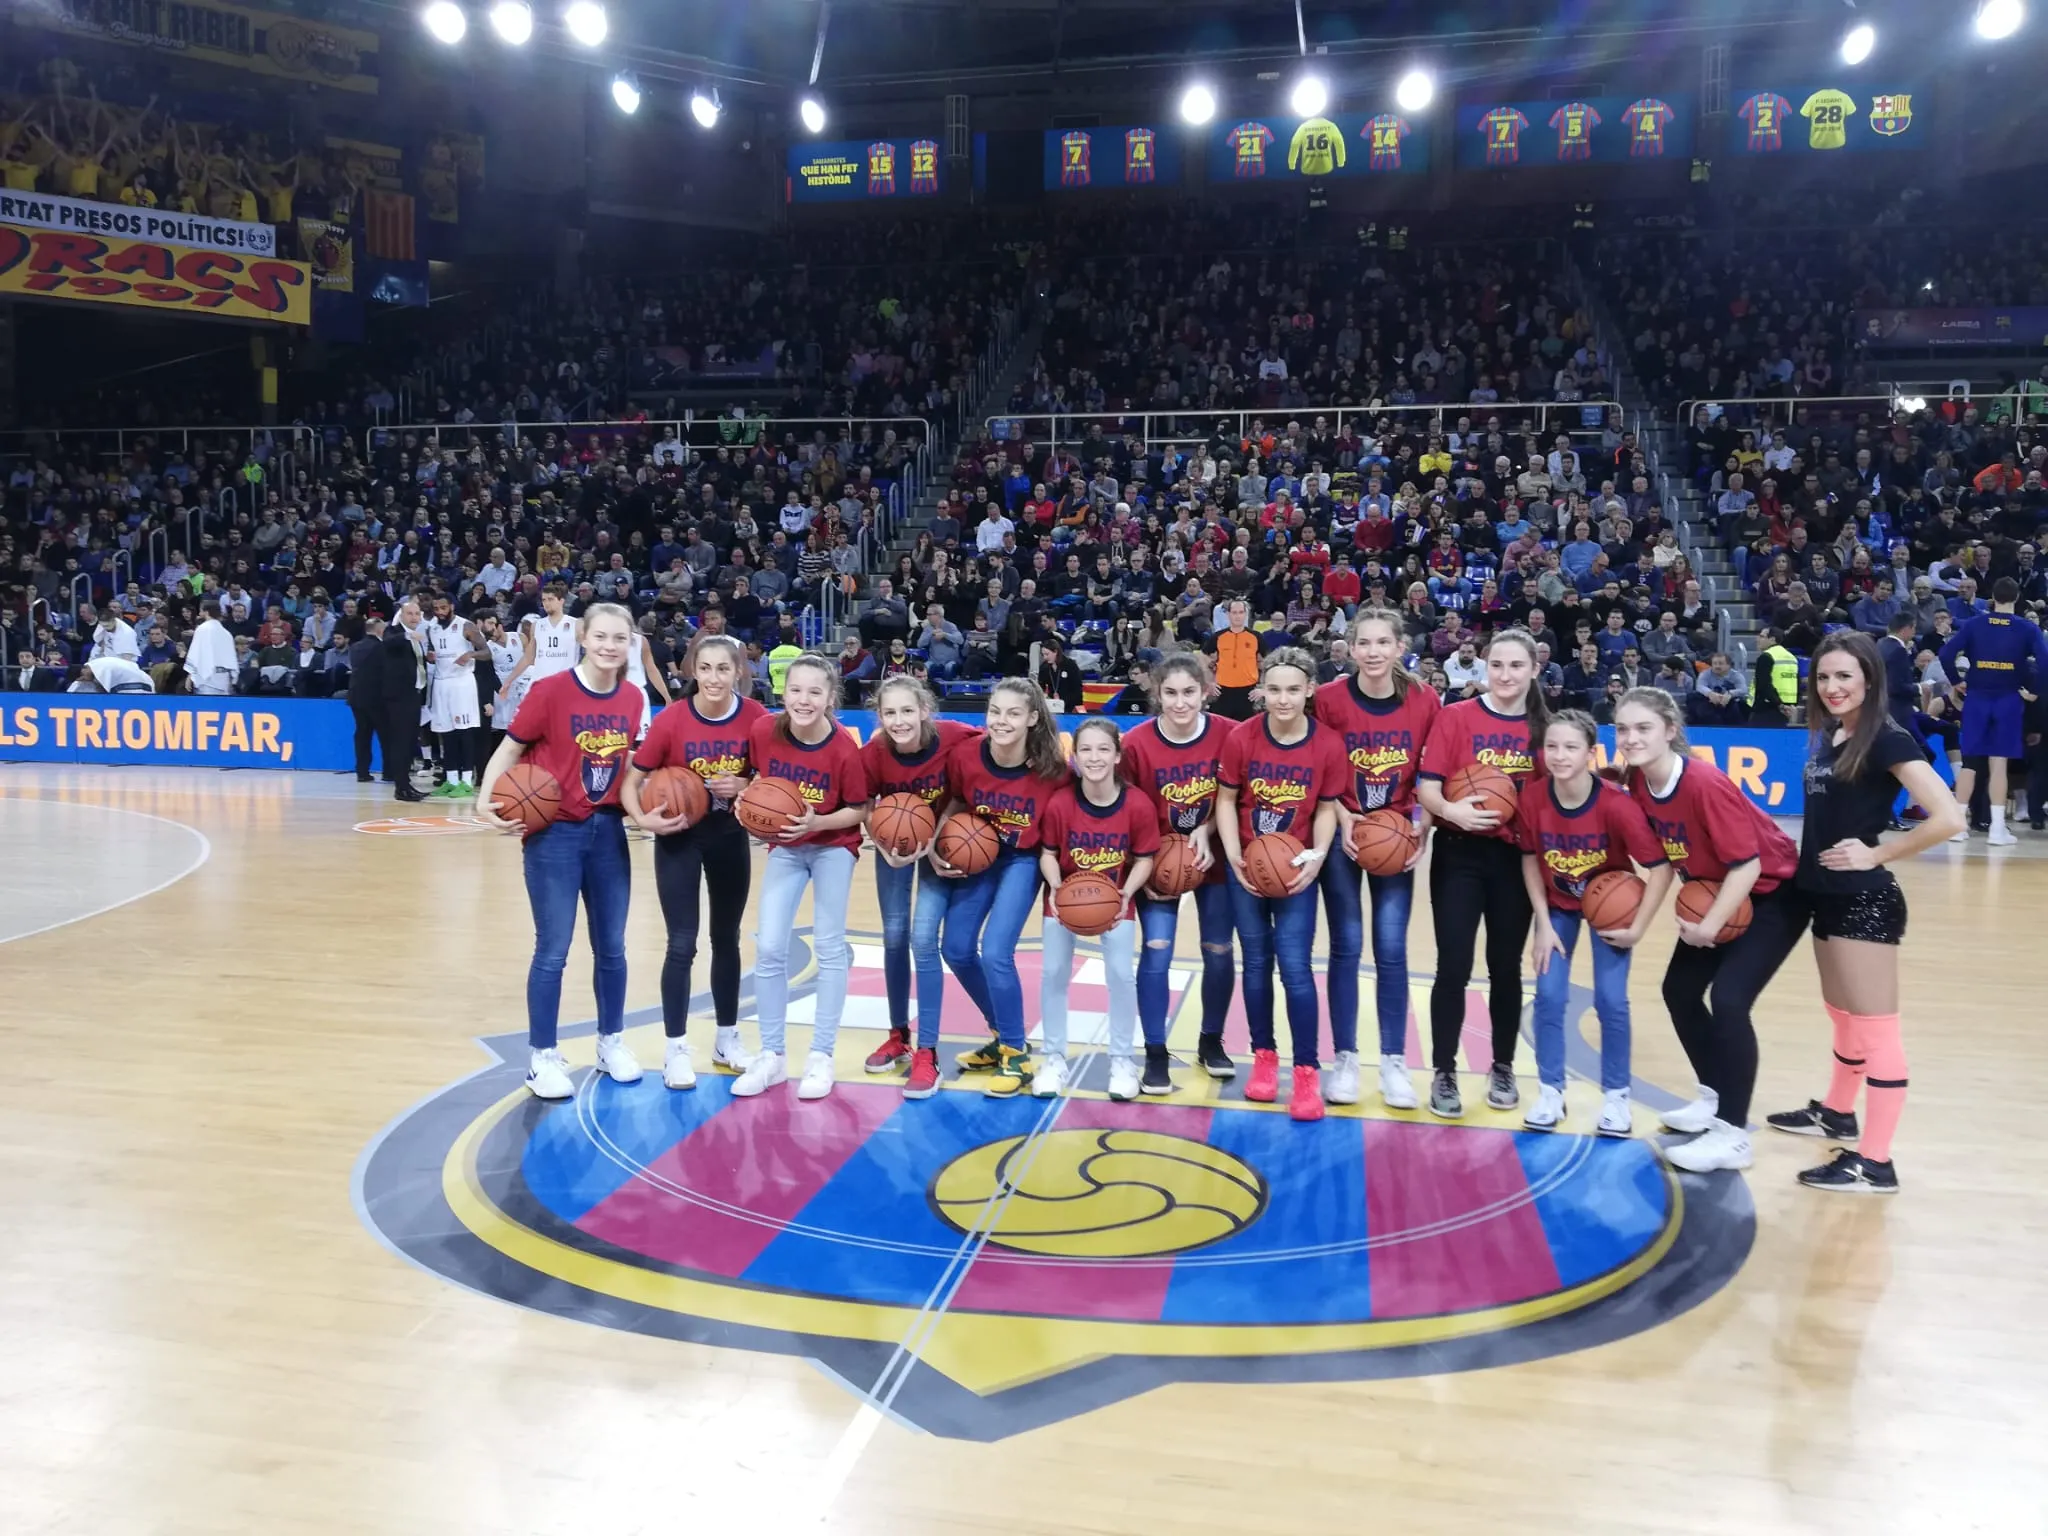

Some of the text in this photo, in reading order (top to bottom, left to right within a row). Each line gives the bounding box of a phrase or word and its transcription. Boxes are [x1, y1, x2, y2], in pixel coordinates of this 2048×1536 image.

[1640, 114, 1655, 133] 4
[1758, 109, 1773, 128] 2
[1814, 105, 1842, 124] 28
[1496, 122, 1510, 141] 7
[1567, 118, 1581, 137] 5
[1239, 137, 1261, 155] 21
[1306, 134, 1329, 151] 16
[1373, 129, 1398, 148] 14
[1069, 146, 1082, 164] 7
[1133, 143, 1147, 160] 4
[800, 163, 859, 177] QUE HAN FET
[870, 156, 891, 174] 15
[913, 154, 934, 172] 12
[60, 206, 142, 235] PRESOS
[147, 218, 245, 247] POLÍTICS!
[439, 638, 447, 649] 11
[548, 636, 559, 648] 10
[507, 653, 514, 663] 3
[49, 708, 293, 762] TRIOMFAR,
[575, 729, 628, 753] Rookies
[690, 755, 746, 778] Rookies
[1349, 746, 1405, 769] Rookies
[1161, 776, 1217, 802] Rookies
[1250, 778, 1306, 801] Rookies
[1070, 847, 1125, 869] Rookies
[1544, 849, 1607, 873] Rookies
